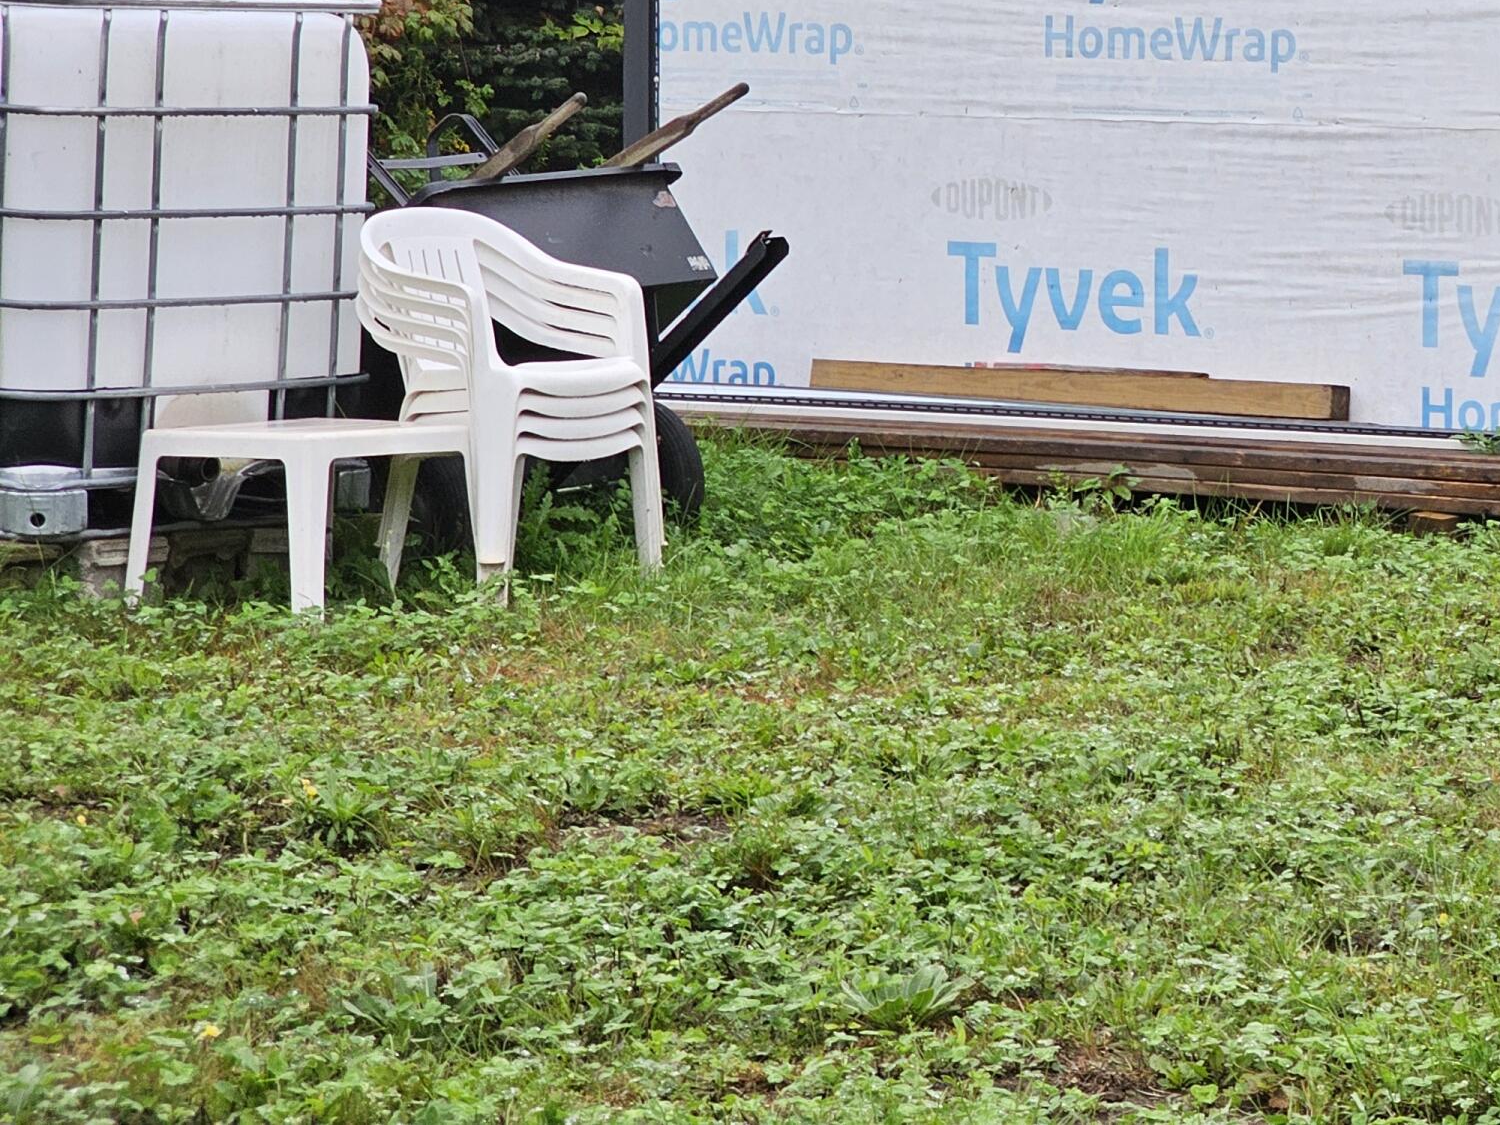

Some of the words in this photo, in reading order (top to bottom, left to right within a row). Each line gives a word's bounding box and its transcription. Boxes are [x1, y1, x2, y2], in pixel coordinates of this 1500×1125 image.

[1045, 13, 1296, 73] HomeWrap
[945, 178, 1041, 221] DUPONT
[947, 240, 1202, 355] Tyvek
